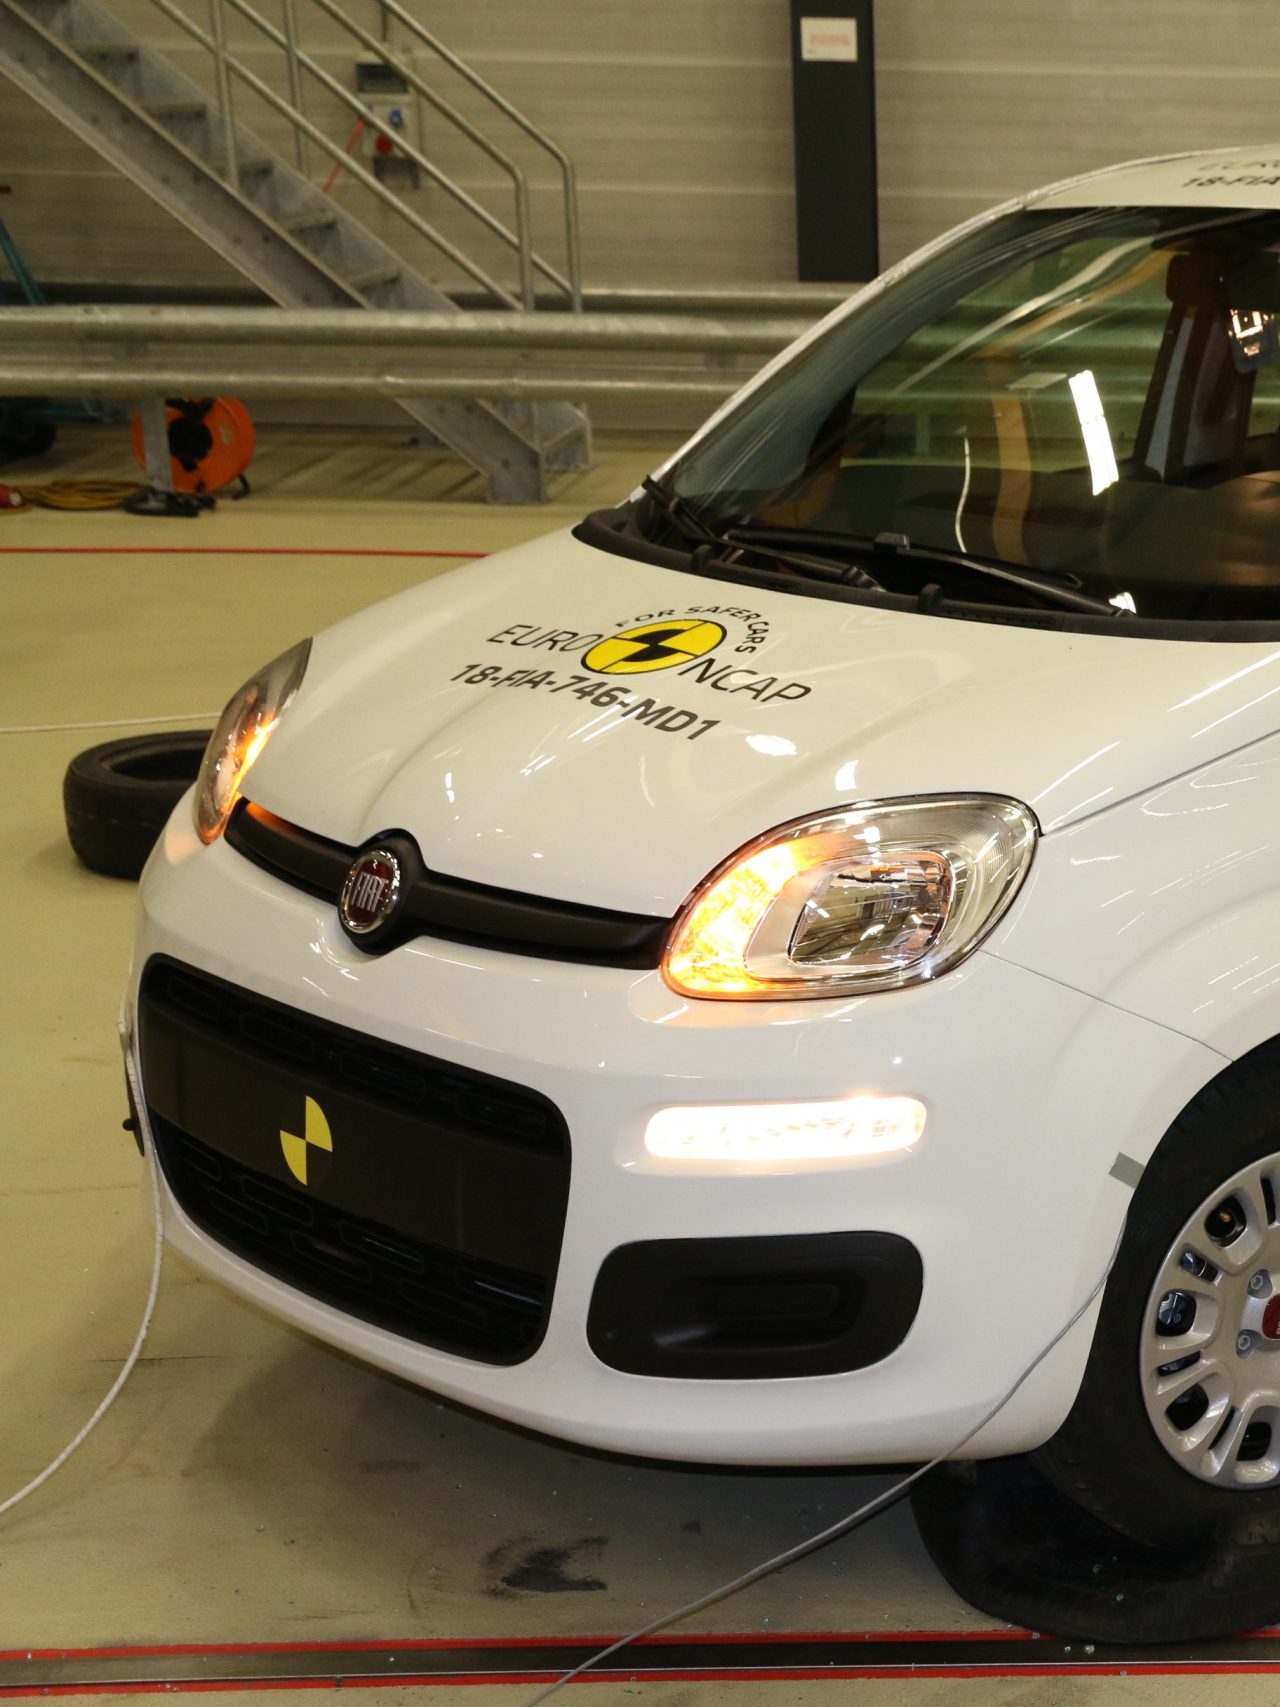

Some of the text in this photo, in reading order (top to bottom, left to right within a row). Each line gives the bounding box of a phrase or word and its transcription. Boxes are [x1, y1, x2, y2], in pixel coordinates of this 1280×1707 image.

[614, 605, 770, 654] FOR SAFER CARS
[486, 623, 812, 704] EURO NCAP
[449, 663, 723, 741] 18-FIA-746-MD1
[350, 870, 389, 913] FIAT
